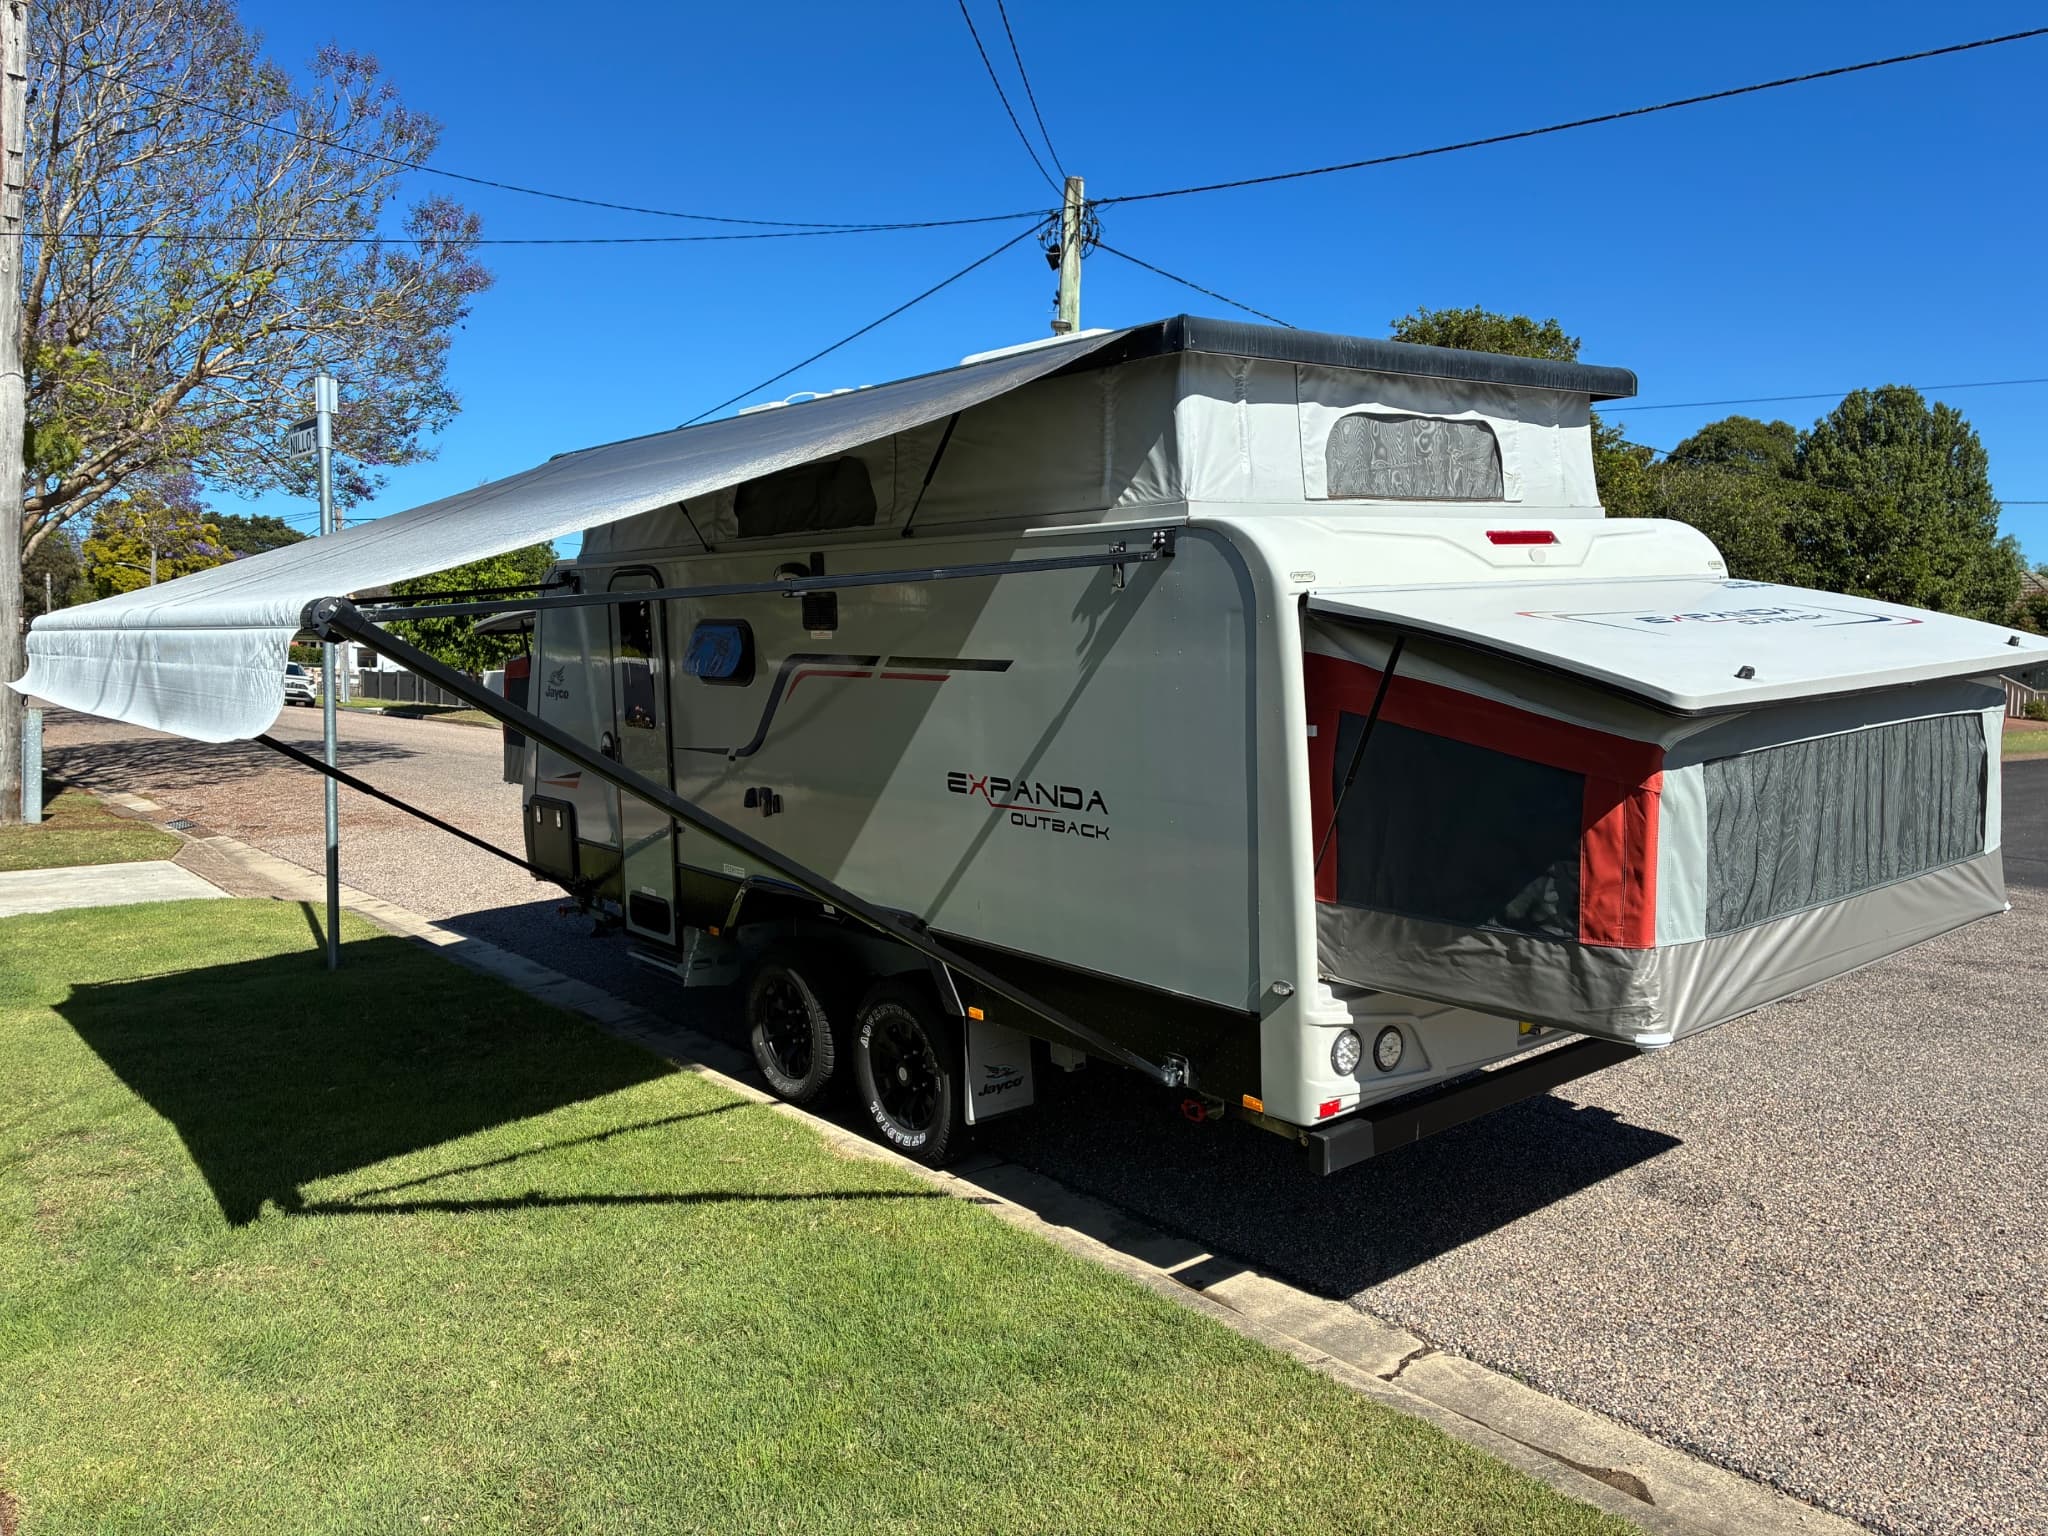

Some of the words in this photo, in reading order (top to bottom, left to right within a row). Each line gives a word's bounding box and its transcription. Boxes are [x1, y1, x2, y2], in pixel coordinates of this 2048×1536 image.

[290, 431, 311, 456] NILLO
[1633, 607, 1804, 624] EXPANDA
[1737, 614, 1828, 625] OUTBACK
[545, 685, 569, 701] Jayco
[947, 771, 1109, 815] EXPANDA
[1010, 812, 1110, 840] OUTBACK
[978, 1075, 1025, 1097] Jayco
